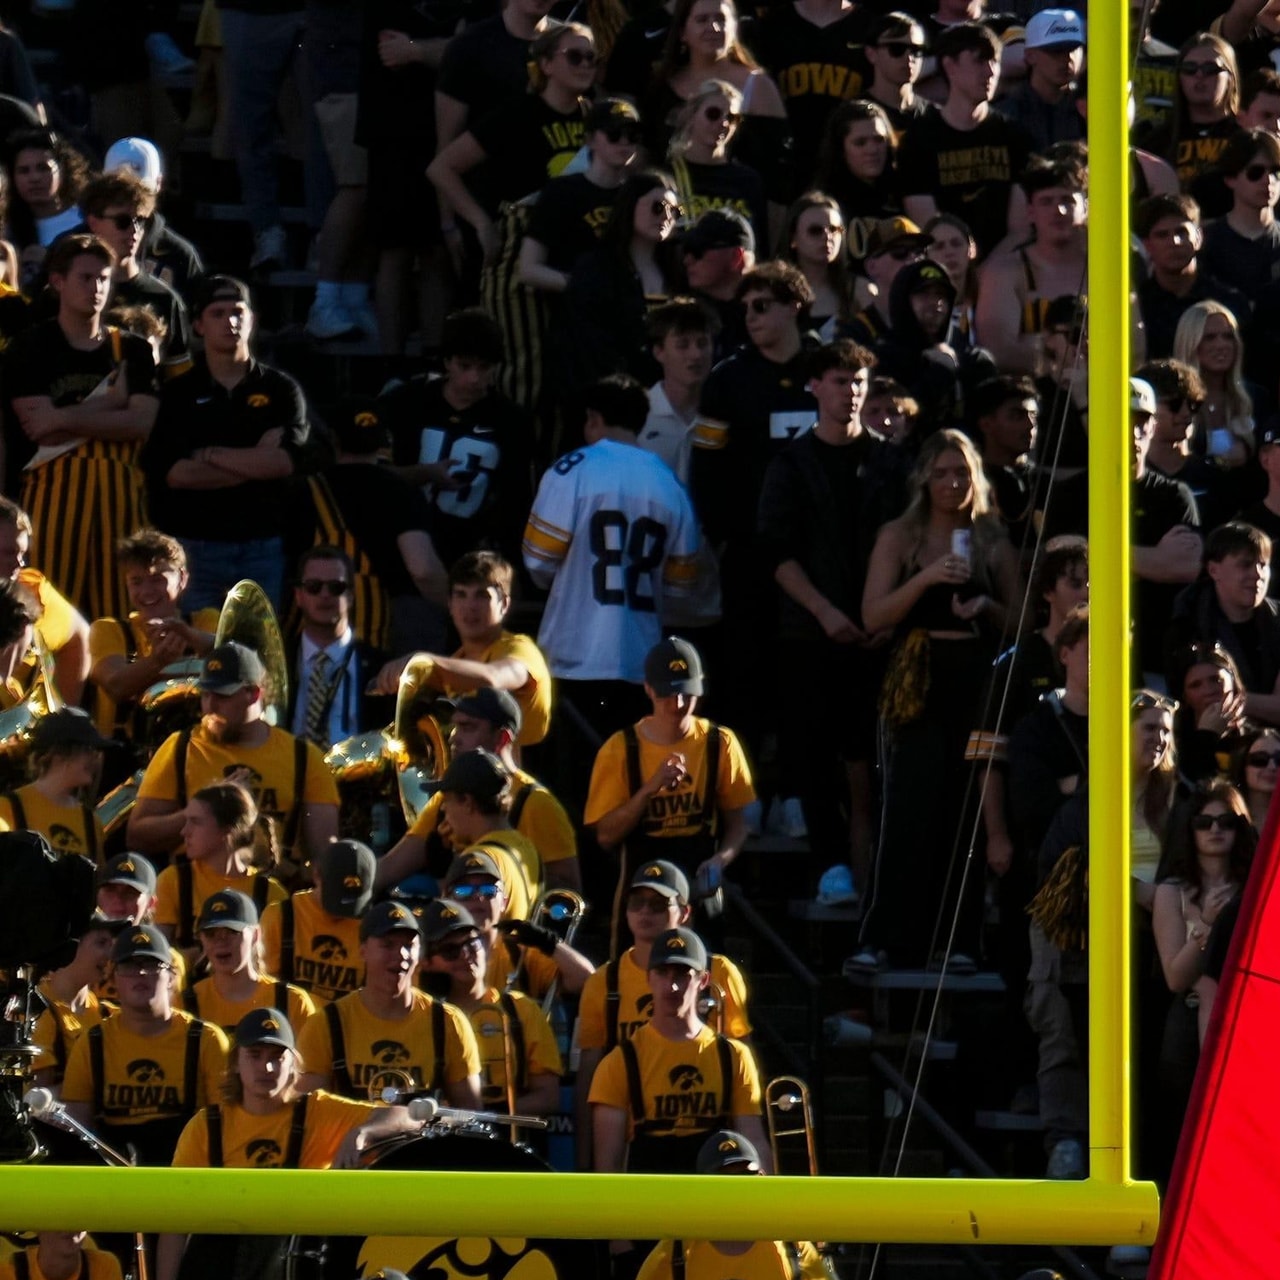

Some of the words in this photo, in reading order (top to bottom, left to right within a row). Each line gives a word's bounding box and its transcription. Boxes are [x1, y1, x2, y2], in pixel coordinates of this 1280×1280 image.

[778, 61, 863, 101] IOWA
[590, 510, 667, 612] 88
[107, 1084, 181, 1108] IOWA
[653, 1092, 718, 1119] IOWA
